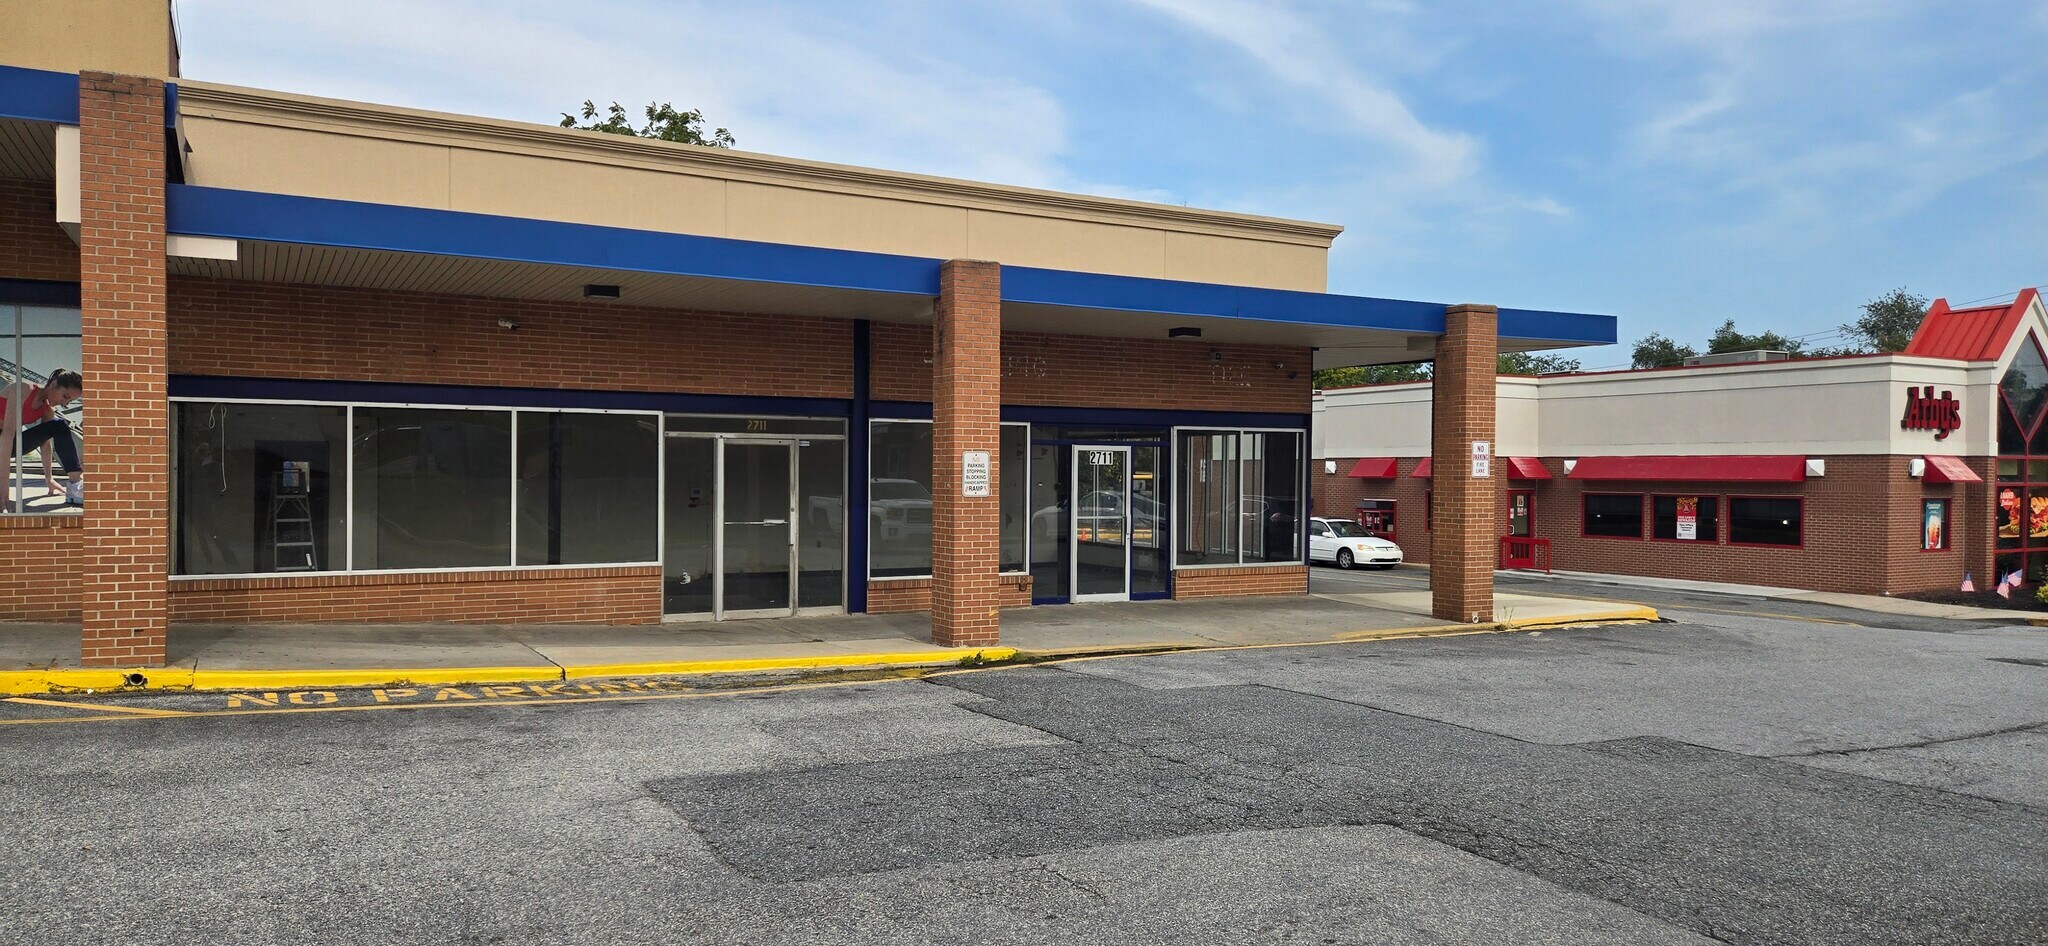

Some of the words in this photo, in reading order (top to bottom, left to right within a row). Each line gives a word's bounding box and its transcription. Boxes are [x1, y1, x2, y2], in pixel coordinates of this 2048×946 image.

[1902, 386, 1961, 441] Arby's
[747, 420, 767, 431] 2711
[1090, 451, 1112, 464] 2711
[228, 691, 338, 708] NO
[372, 681, 693, 702] PARKING
